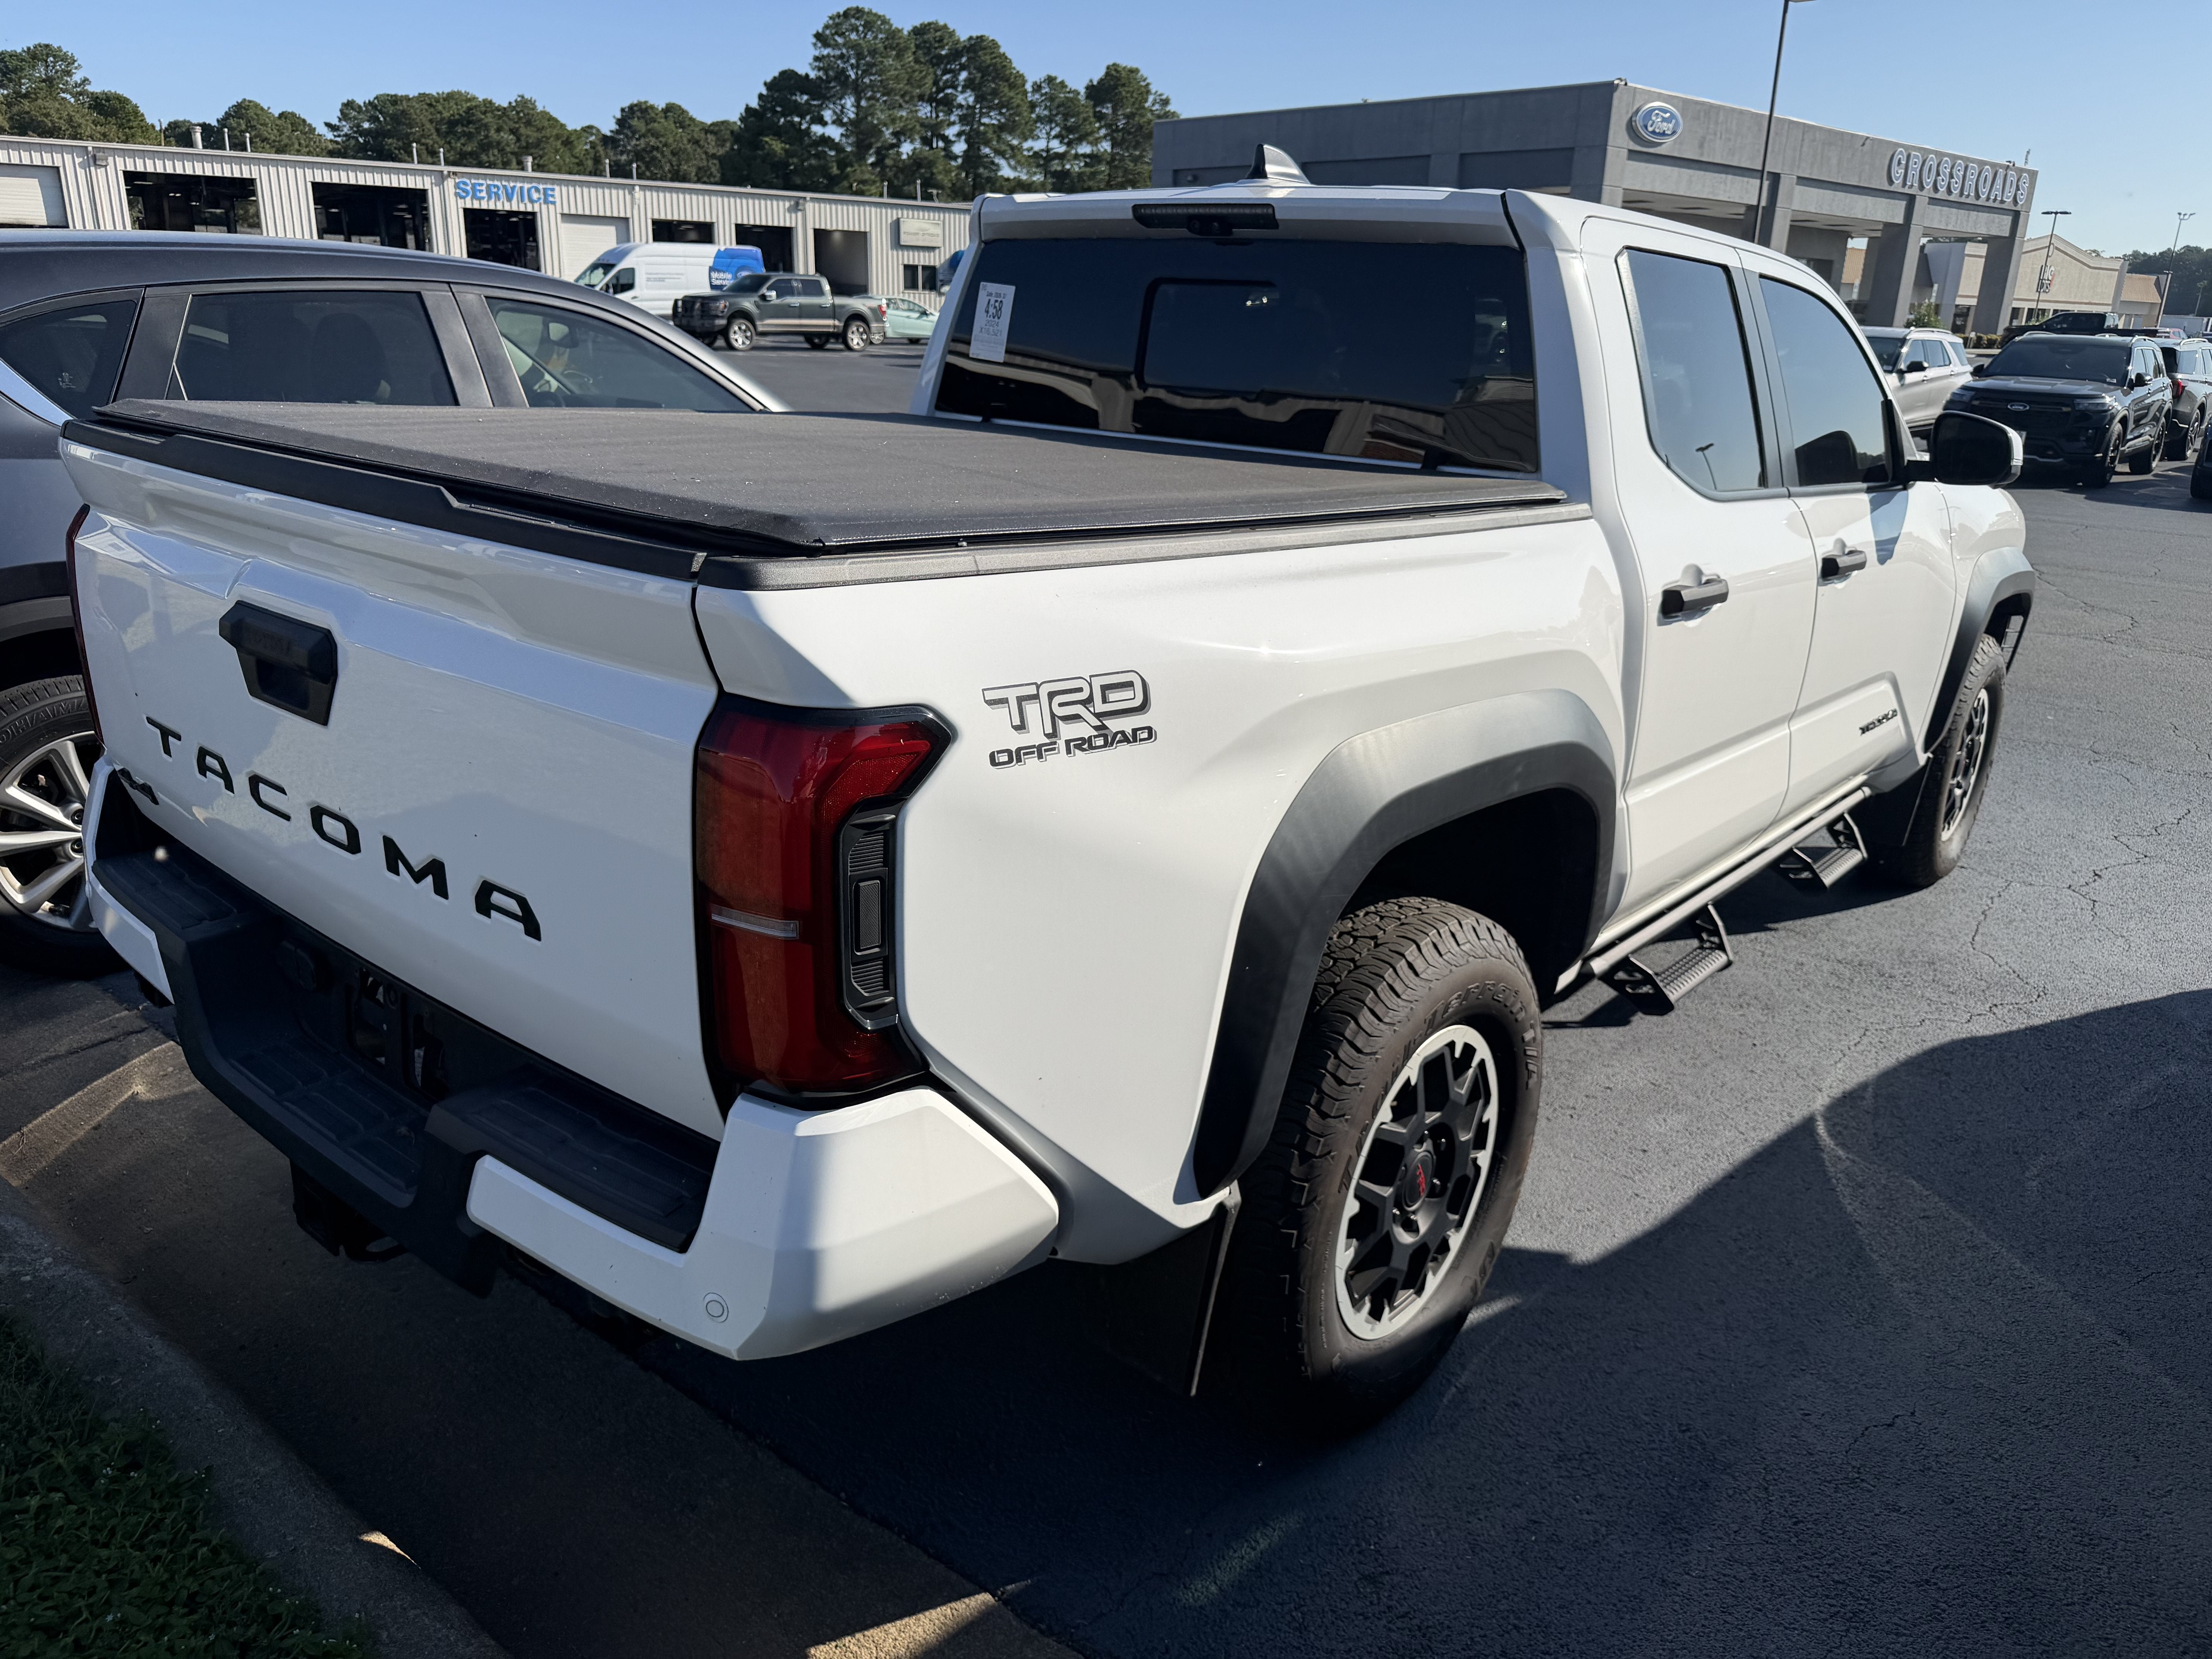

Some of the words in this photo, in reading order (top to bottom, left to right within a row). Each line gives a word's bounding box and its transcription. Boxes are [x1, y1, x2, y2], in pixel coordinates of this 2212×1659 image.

[1647, 110, 1676, 134] Ford
[456, 180, 556, 204] SERVICE
[1891, 148, 2029, 204] CROSSROADS
[982, 670, 1151, 741] TRD
[989, 741, 1060, 769] OFF
[1065, 726, 1157, 757] ROAD
[146, 716, 541, 941] TACOMA
